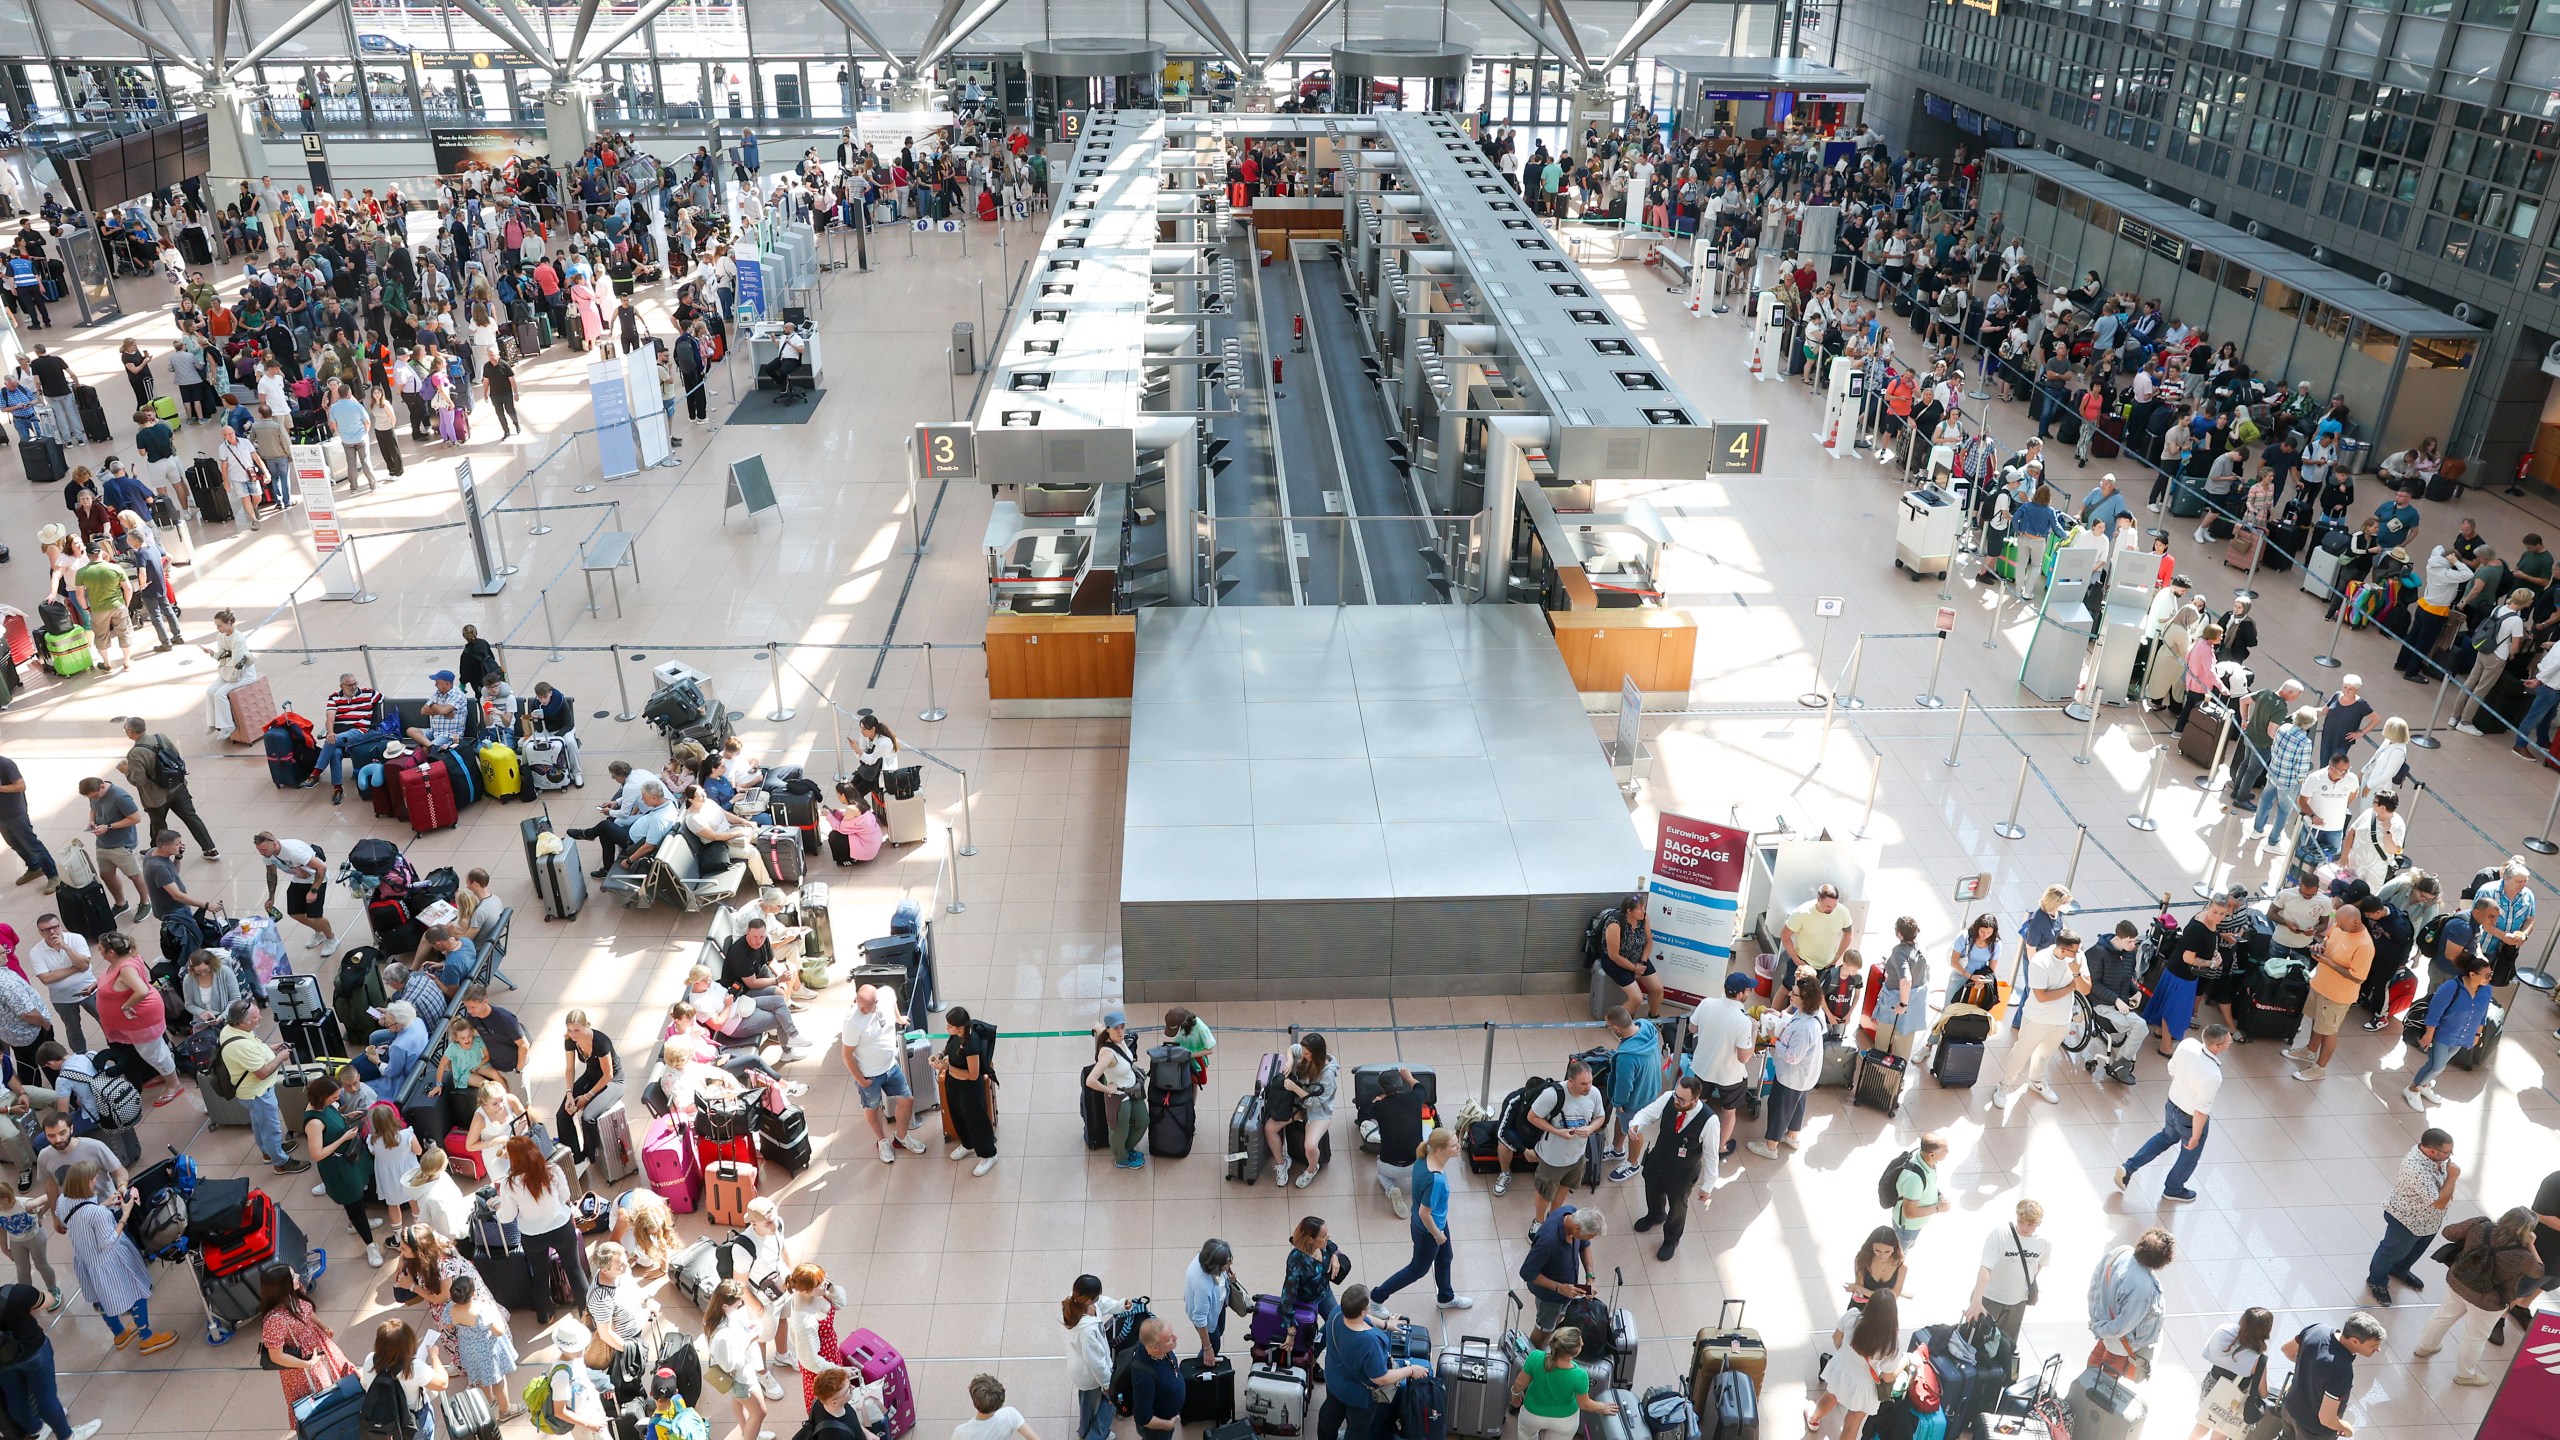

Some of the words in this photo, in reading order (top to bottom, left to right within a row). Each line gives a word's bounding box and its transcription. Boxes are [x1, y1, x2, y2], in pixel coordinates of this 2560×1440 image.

[1066, 115, 1078, 131] 3
[1461, 118, 1471, 133] 4
[934, 435, 955, 463] 3
[1729, 431, 1750, 458] 4
[1666, 825, 1710, 843] Eurowings
[1662, 849, 1699, 868] DROP
[1664, 838, 1730, 862] BAGGAGE
